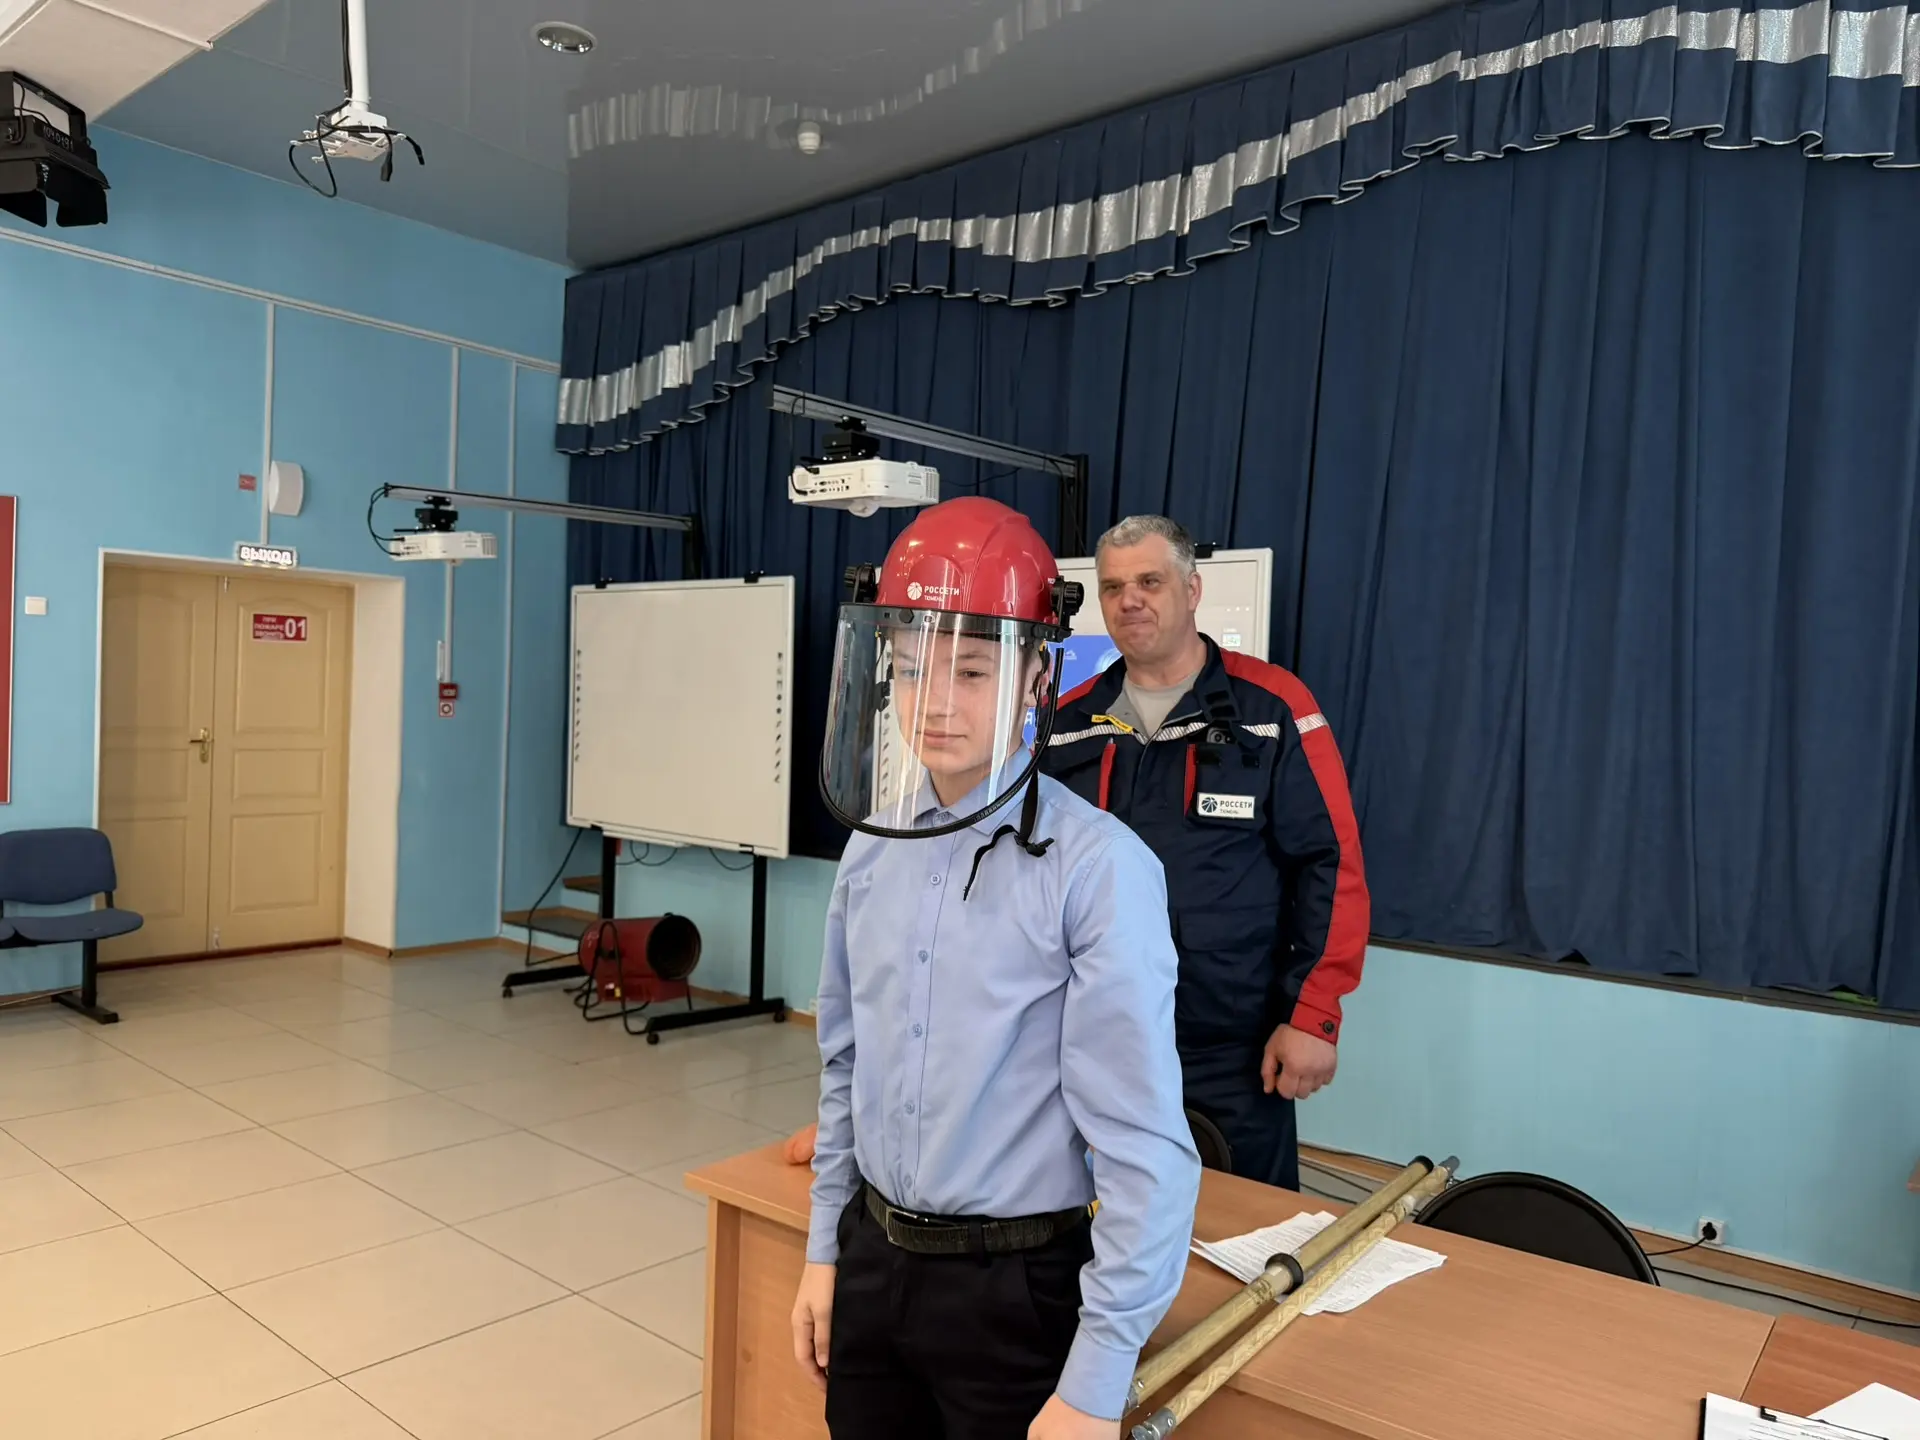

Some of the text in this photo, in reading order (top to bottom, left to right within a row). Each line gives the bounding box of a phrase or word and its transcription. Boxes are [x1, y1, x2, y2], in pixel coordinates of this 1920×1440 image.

[240, 546, 292, 565] ВЫХОД
[924, 585, 960, 596] РОССЕТИ
[285, 618, 306, 639] 01
[1220, 800, 1253, 809] РОССЕТИ
